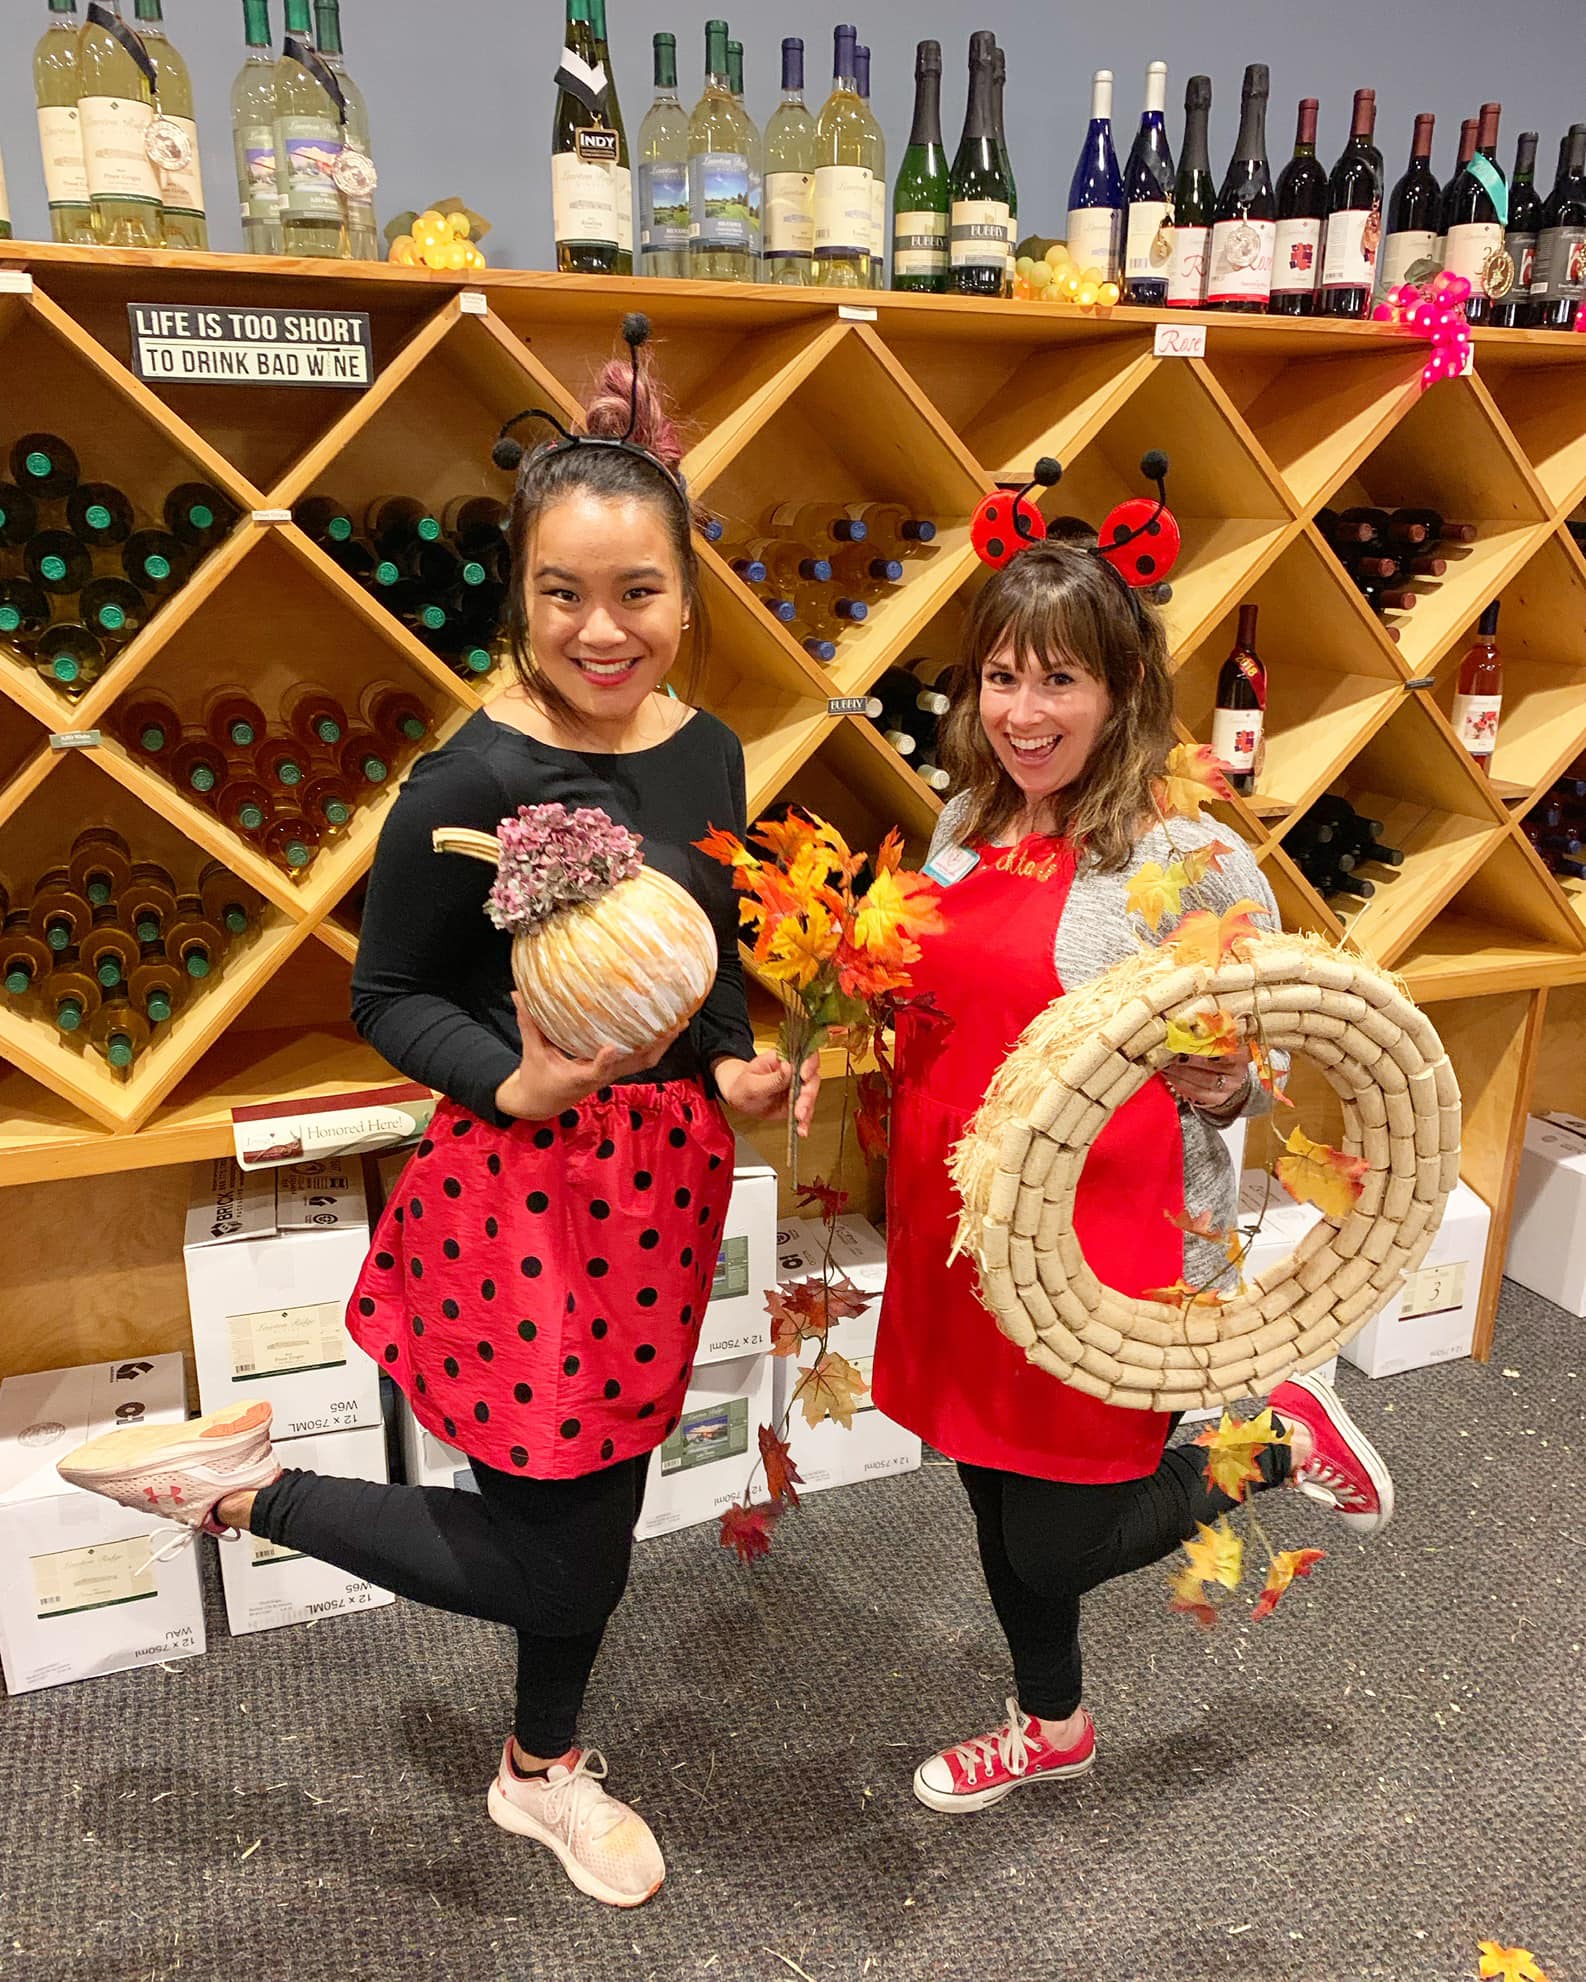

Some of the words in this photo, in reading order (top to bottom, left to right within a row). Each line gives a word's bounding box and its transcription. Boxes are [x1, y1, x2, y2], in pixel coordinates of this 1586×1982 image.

[580, 133, 615, 147] INDY
[136, 311, 191, 336] LIFE
[197, 313, 223, 337] IS
[228, 314, 278, 340] TOO
[285, 316, 363, 343] SHORT
[146, 349, 174, 372] TO
[182, 350, 250, 374] DRINK
[257, 353, 300, 375] BAD
[1234, 652, 1257, 677] 2018
[307, 1120, 365, 1140] Honored
[368, 1115, 405, 1132] Here!
[216, 1190, 235, 1221] BRICK
[1429, 1281, 1441, 1302] 3
[709, 1338, 741, 1353] 750ml
[751, 1335, 763, 1345] 12
[329, 1399, 358, 1413] W65
[288, 1418, 331, 1433] 750ML
[344, 1414, 358, 1424] 12
[751, 1484, 762, 1494] 12
[345, 1583, 373, 1594] W65
[359, 1593, 372, 1603] 12
[305, 1599, 346, 1615] 750ML
[164, 1625, 193, 1641] WAU
[181, 1636, 196, 1647] 12
[134, 1643, 170, 1659] 750ml
